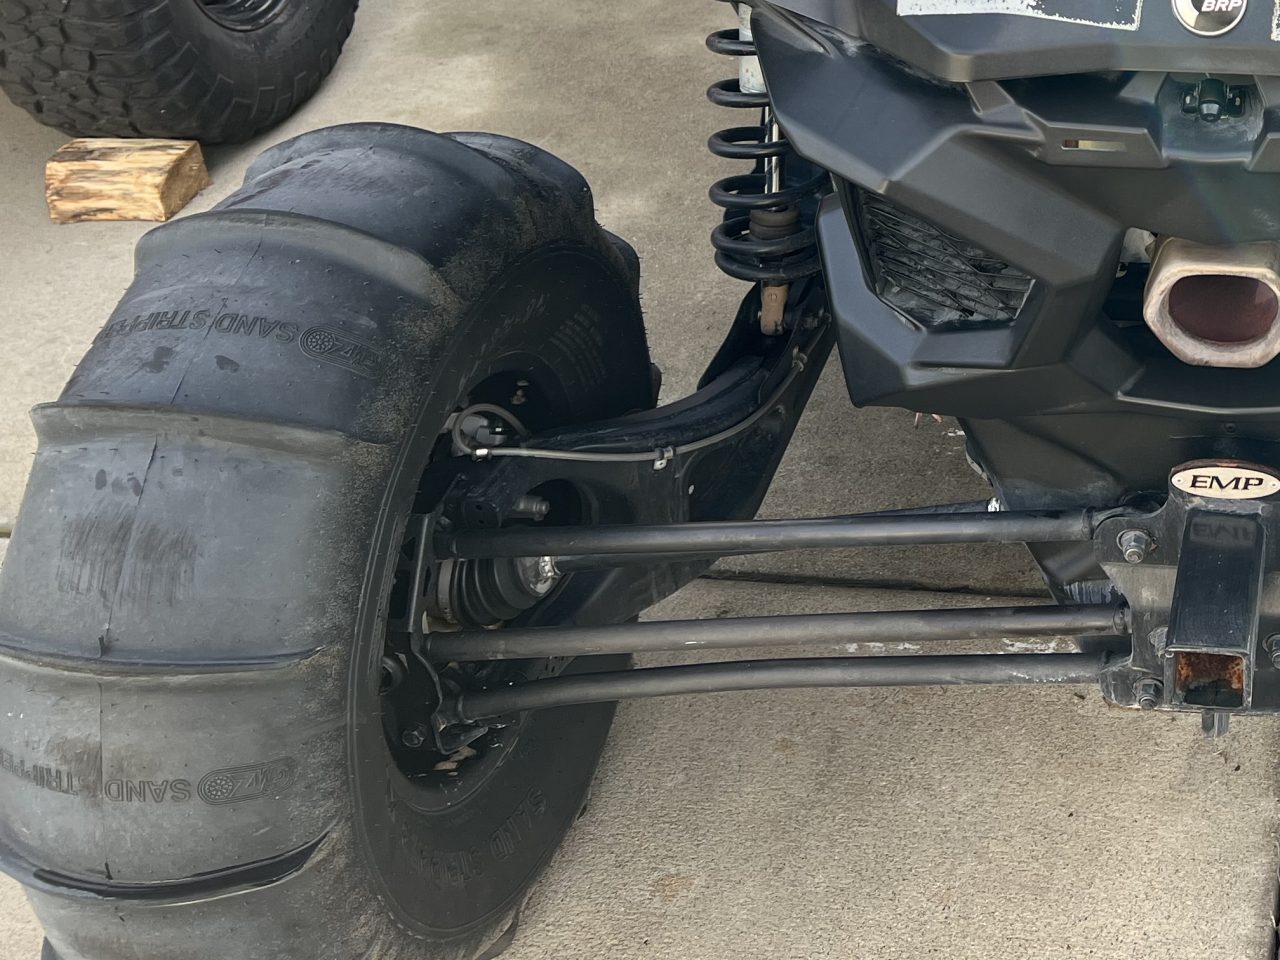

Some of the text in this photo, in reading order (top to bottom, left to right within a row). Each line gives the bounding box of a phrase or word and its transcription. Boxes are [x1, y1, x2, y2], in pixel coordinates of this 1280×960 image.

[212, 312, 300, 344] SAND
[1190, 474, 1264, 491] EMP
[104, 779, 191, 804] SAND
